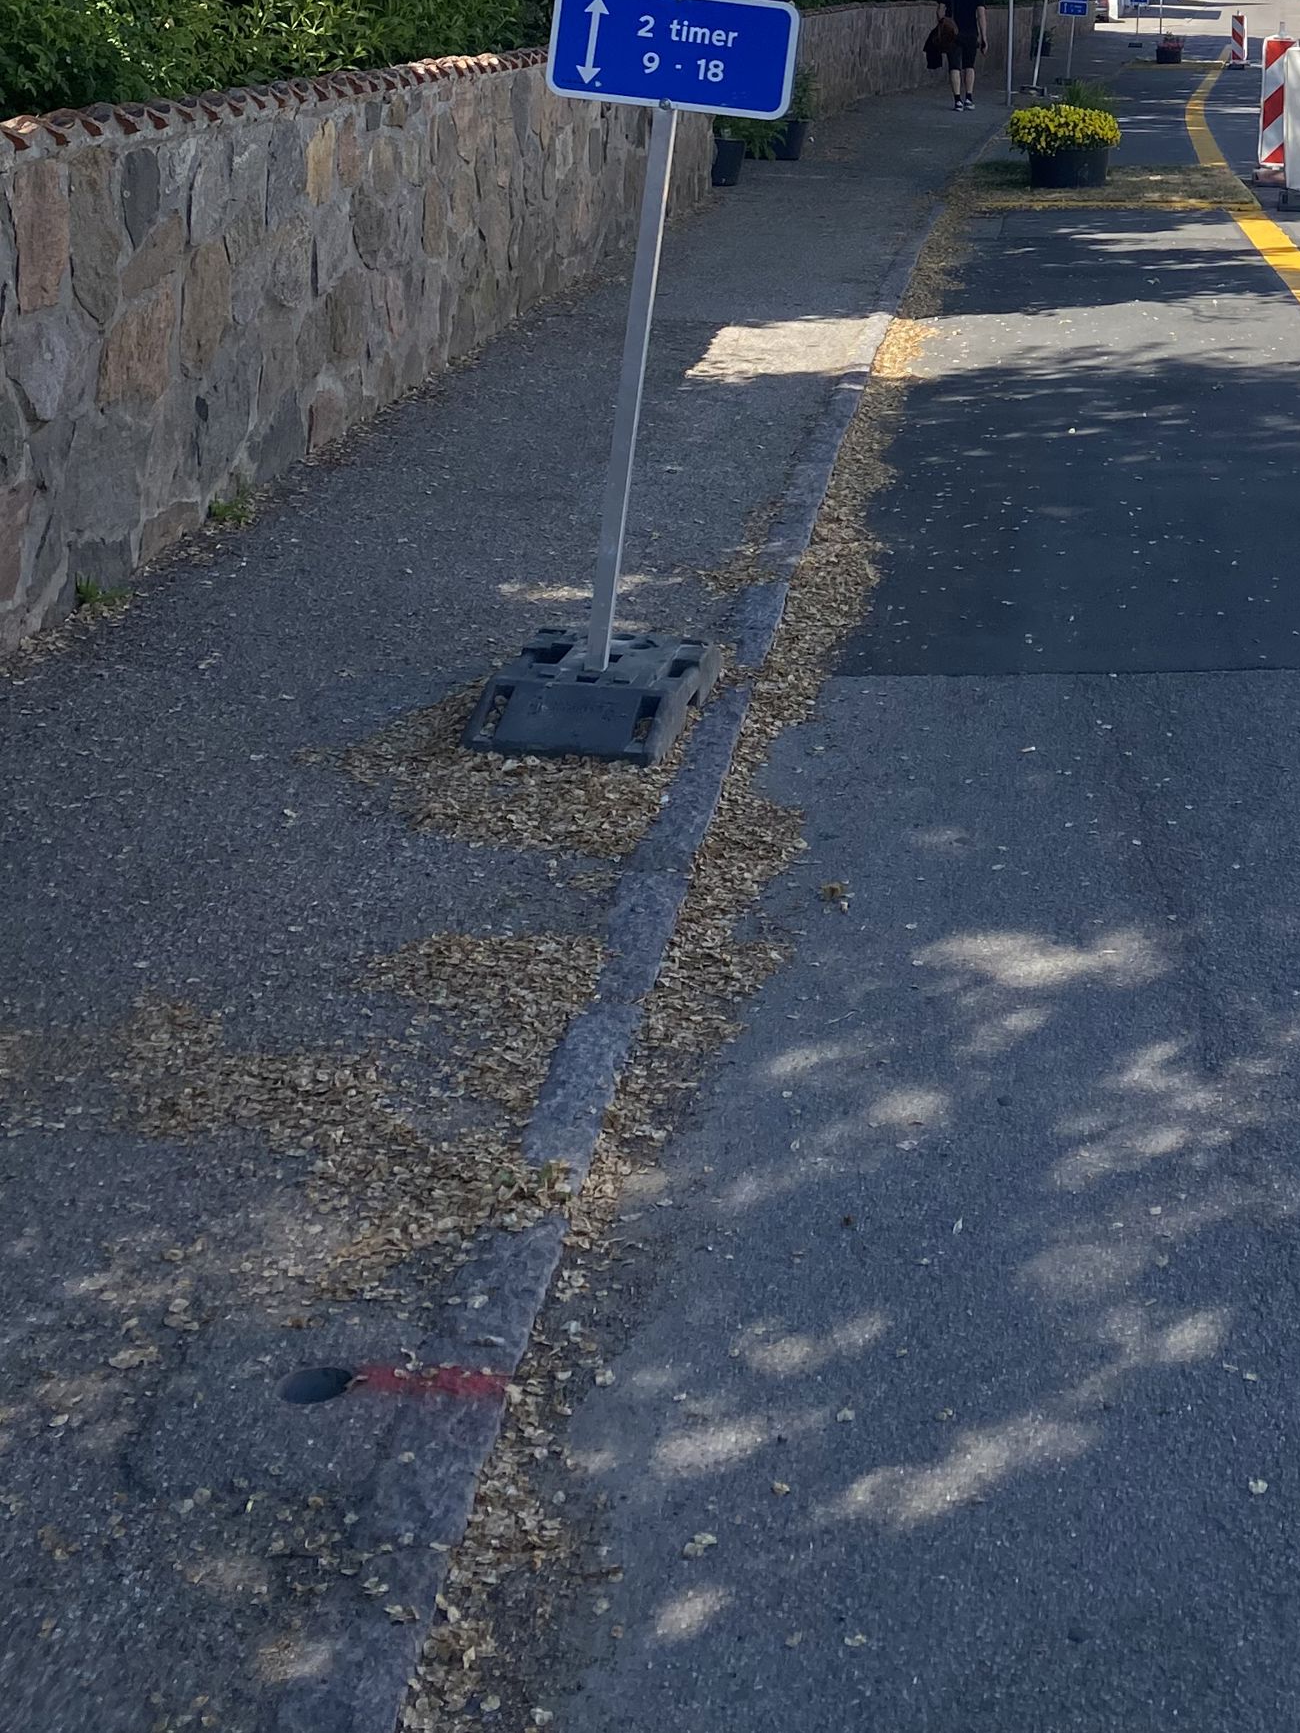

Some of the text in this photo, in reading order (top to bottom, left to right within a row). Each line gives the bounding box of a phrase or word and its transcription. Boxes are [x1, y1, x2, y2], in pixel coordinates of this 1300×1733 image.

[637, 15, 738, 47] 2 timer
[643, 52, 660, 73] 9
[697, 59, 724, 82] 18
